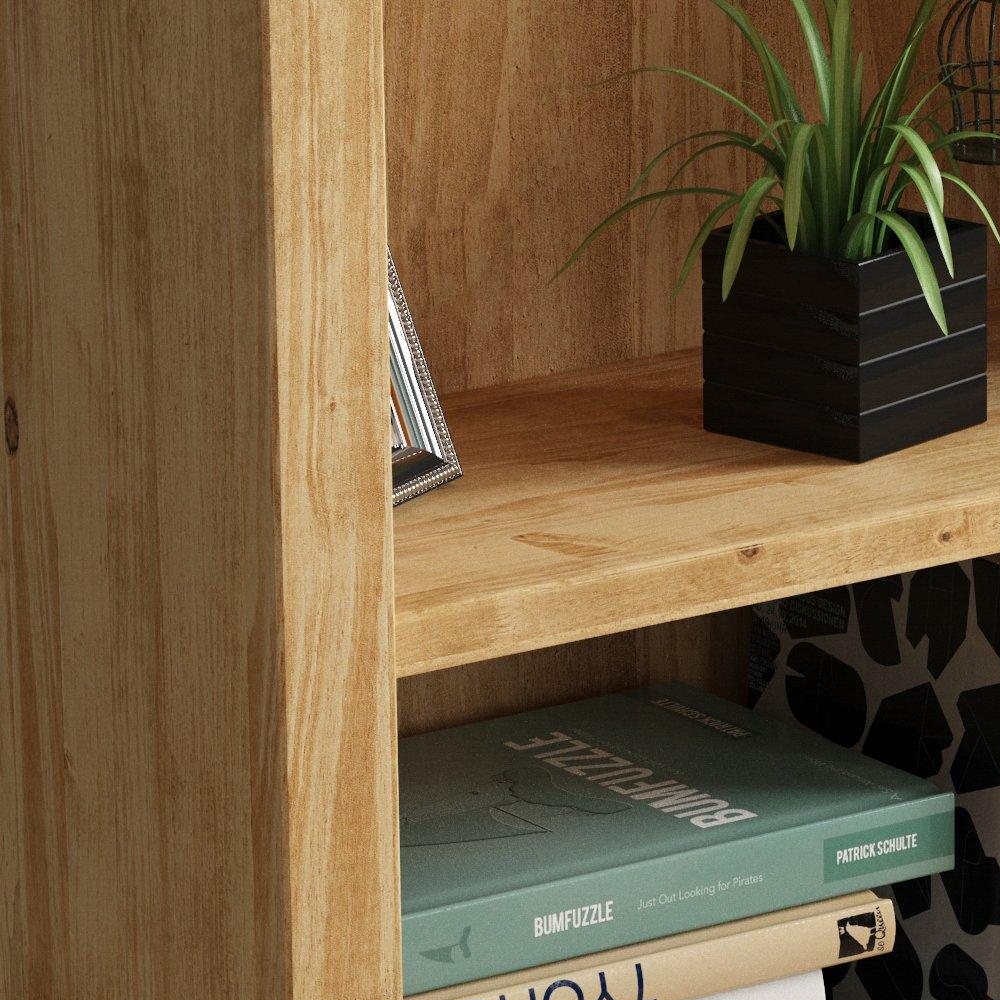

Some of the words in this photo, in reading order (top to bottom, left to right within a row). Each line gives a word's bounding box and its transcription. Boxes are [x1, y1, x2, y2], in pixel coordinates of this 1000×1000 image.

[503, 730, 757, 830] BUMFUZZLE
[836, 842, 876, 865] PATRICK
[877, 833, 918, 856] SCHULTE
[637, 898, 656, 911] Just
[658, 893, 677, 905] Out
[678, 886, 715, 901] Looking
[717, 881, 730, 892] for
[732, 874, 764, 888] Pirates
[533, 900, 614, 938] BUMFUZZLE
